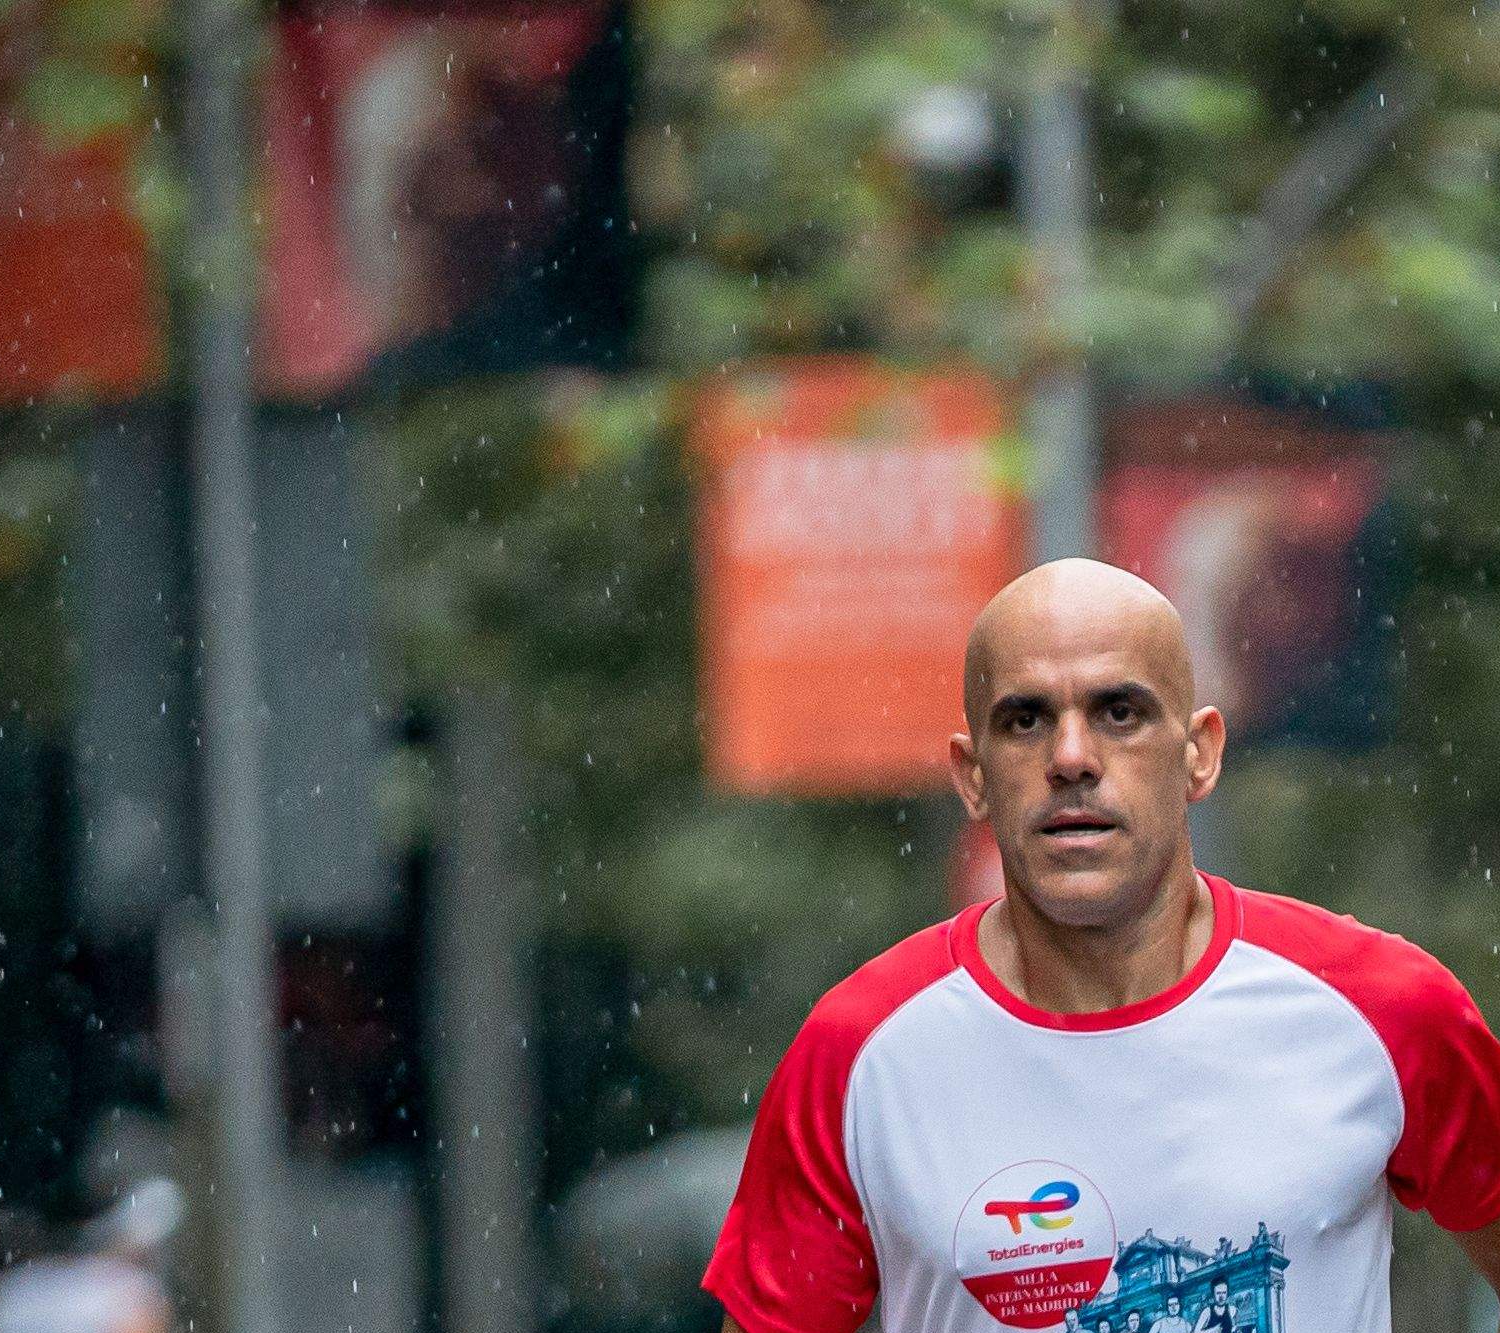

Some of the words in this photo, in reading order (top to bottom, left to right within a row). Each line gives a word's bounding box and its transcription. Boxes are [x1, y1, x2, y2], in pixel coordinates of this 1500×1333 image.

[987, 1237, 1084, 1262] TotalEnergies
[1013, 1271, 1059, 1286] MILLA
[985, 1281, 1094, 1303] INTERNACIONAL
[1001, 1305, 1021, 1318] DE
[1023, 1298, 1078, 1315] MADRID
